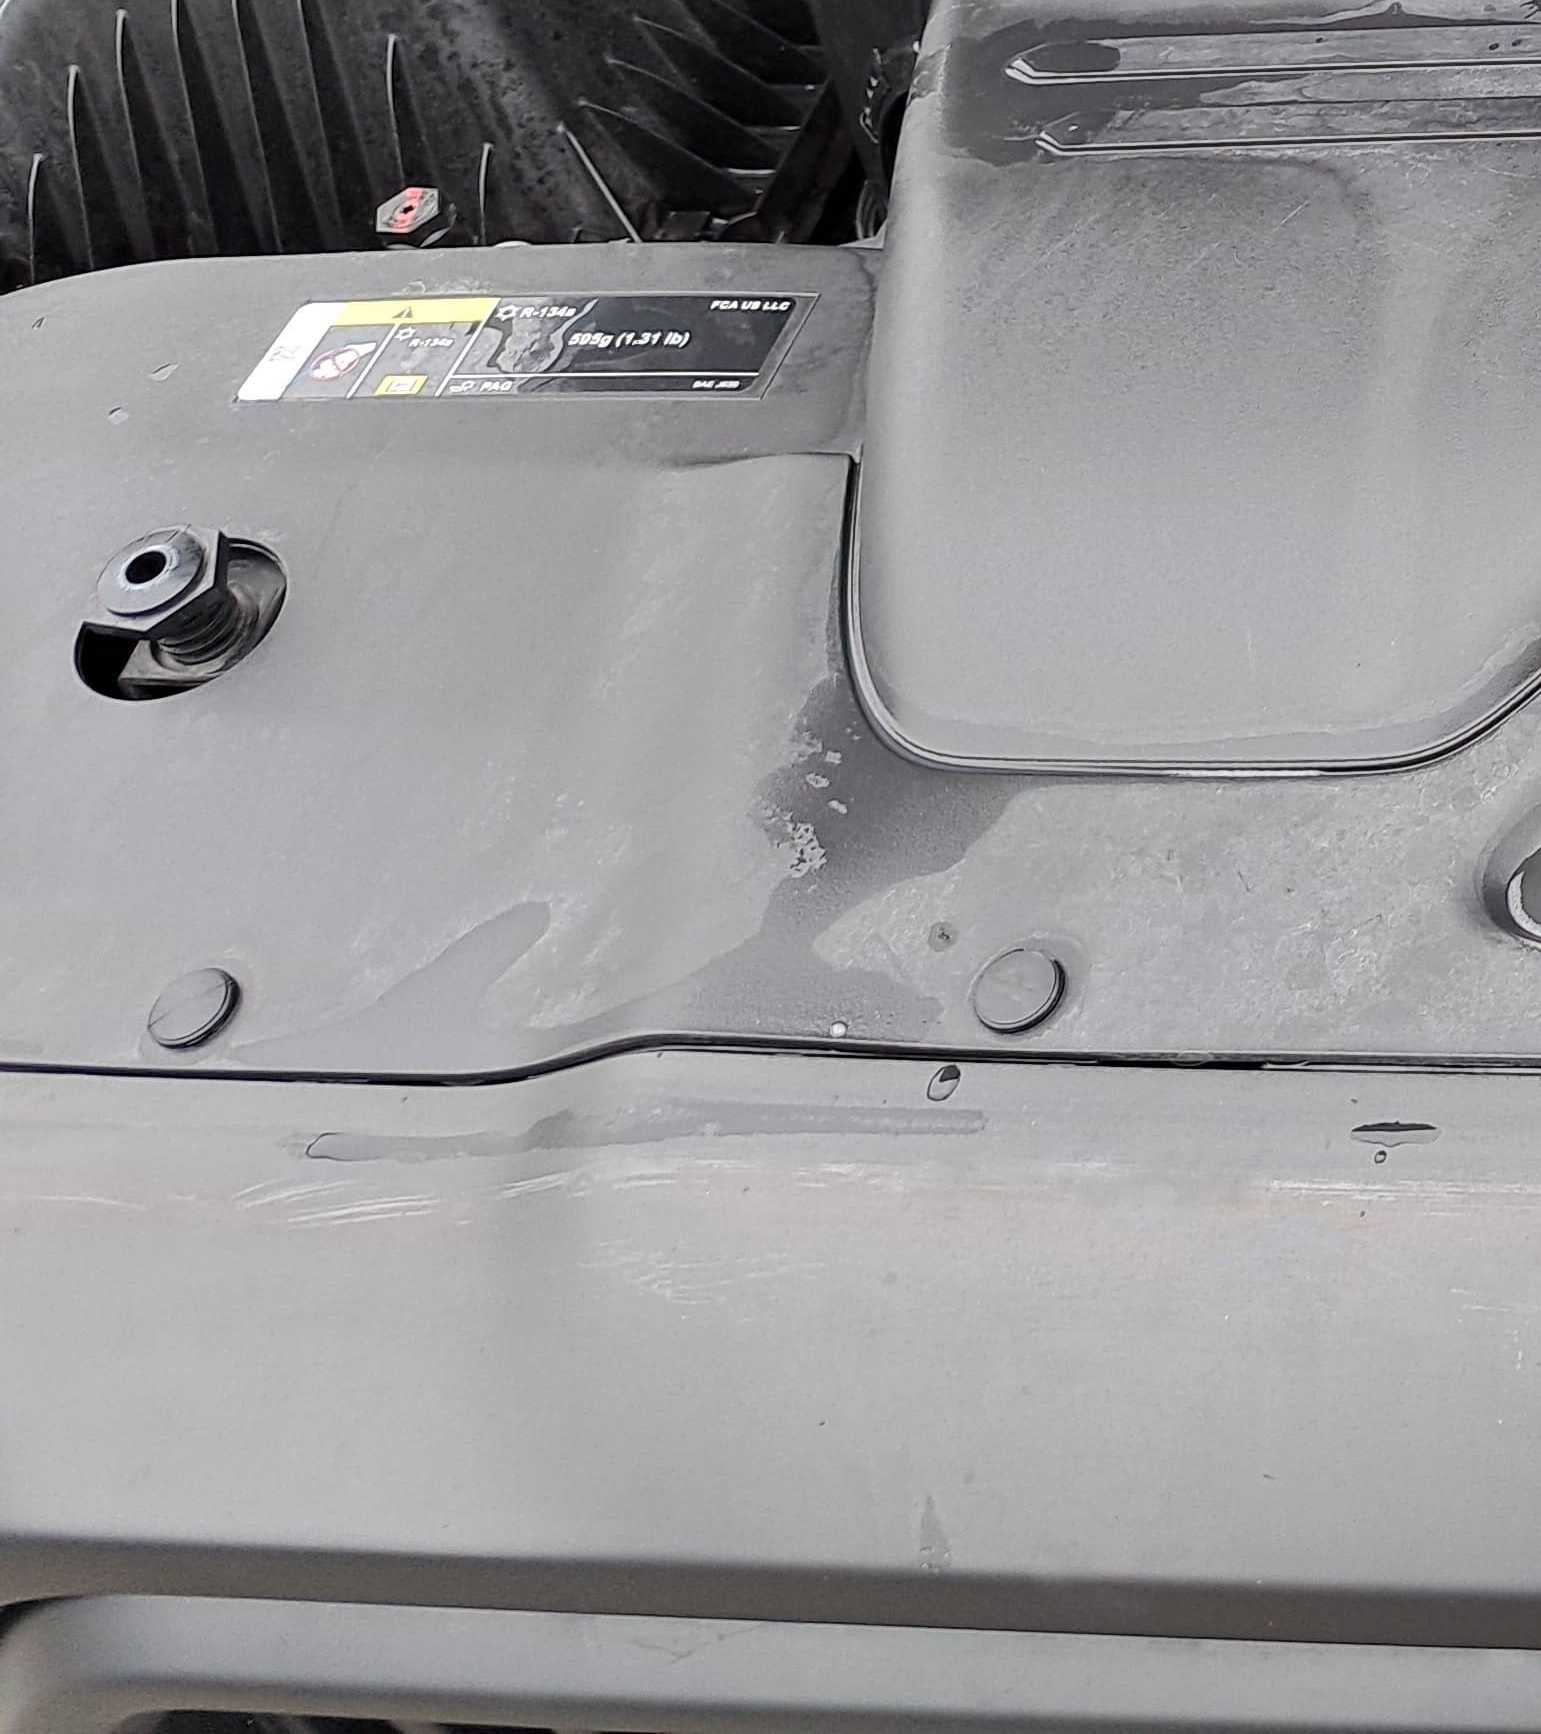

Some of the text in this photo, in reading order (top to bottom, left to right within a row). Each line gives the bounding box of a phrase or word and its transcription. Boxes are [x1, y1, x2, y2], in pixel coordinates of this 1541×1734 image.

[710, 300, 791, 311] FCA US LLC
[663, 331, 691, 348] lb)
[479, 380, 515, 392] PAG
